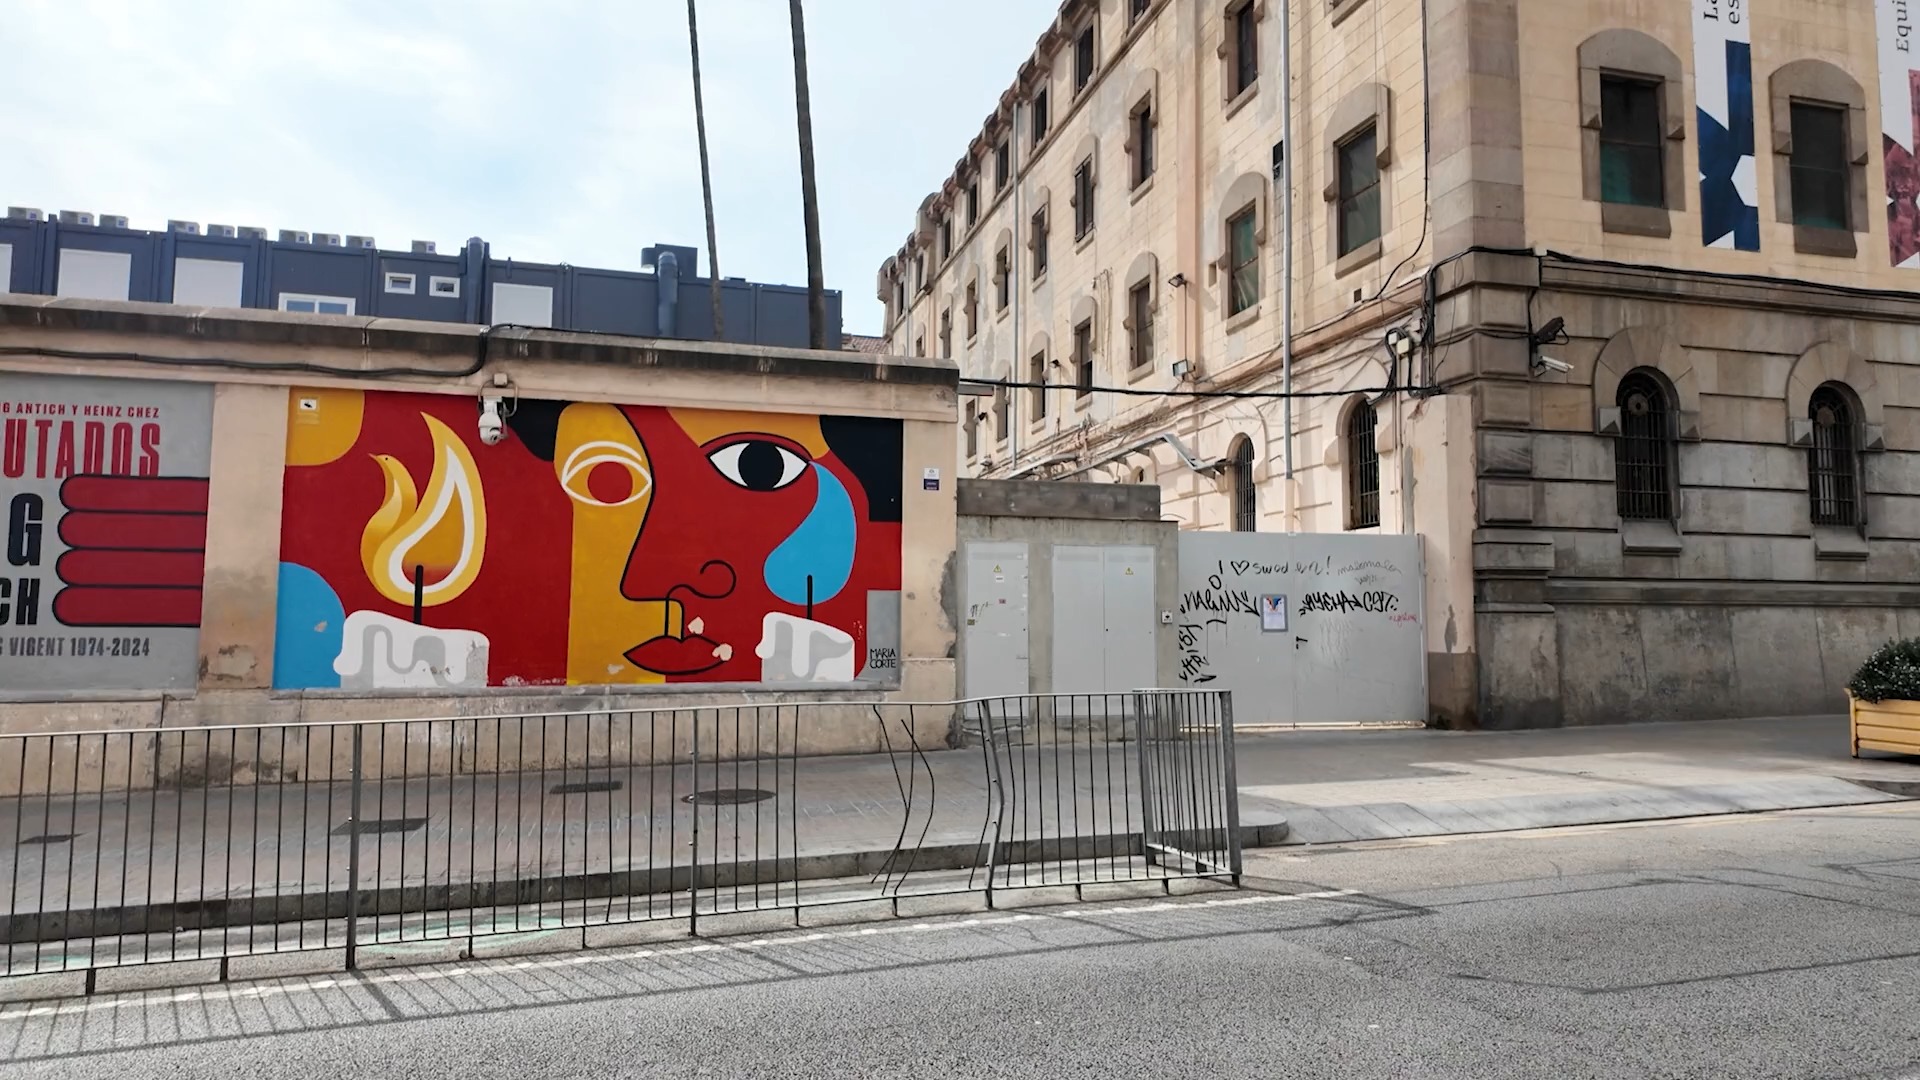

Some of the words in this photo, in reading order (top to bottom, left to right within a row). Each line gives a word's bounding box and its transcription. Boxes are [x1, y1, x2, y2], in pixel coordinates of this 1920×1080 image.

[0, 402, 10, 413] G
[16, 403, 65, 415] ANTICH
[72, 404, 78, 416] Y
[84, 405, 122, 417] HEINZ
[127, 406, 160, 418] CHEZ
[3, 418, 161, 479] UTADOS
[7, 493, 43, 567] G
[10, 637, 65, 656] VIGENT
[70, 637, 150, 656] 1974-2024
[870, 648, 896, 659] MARIA
[870, 659, 897, 668] CORTE
